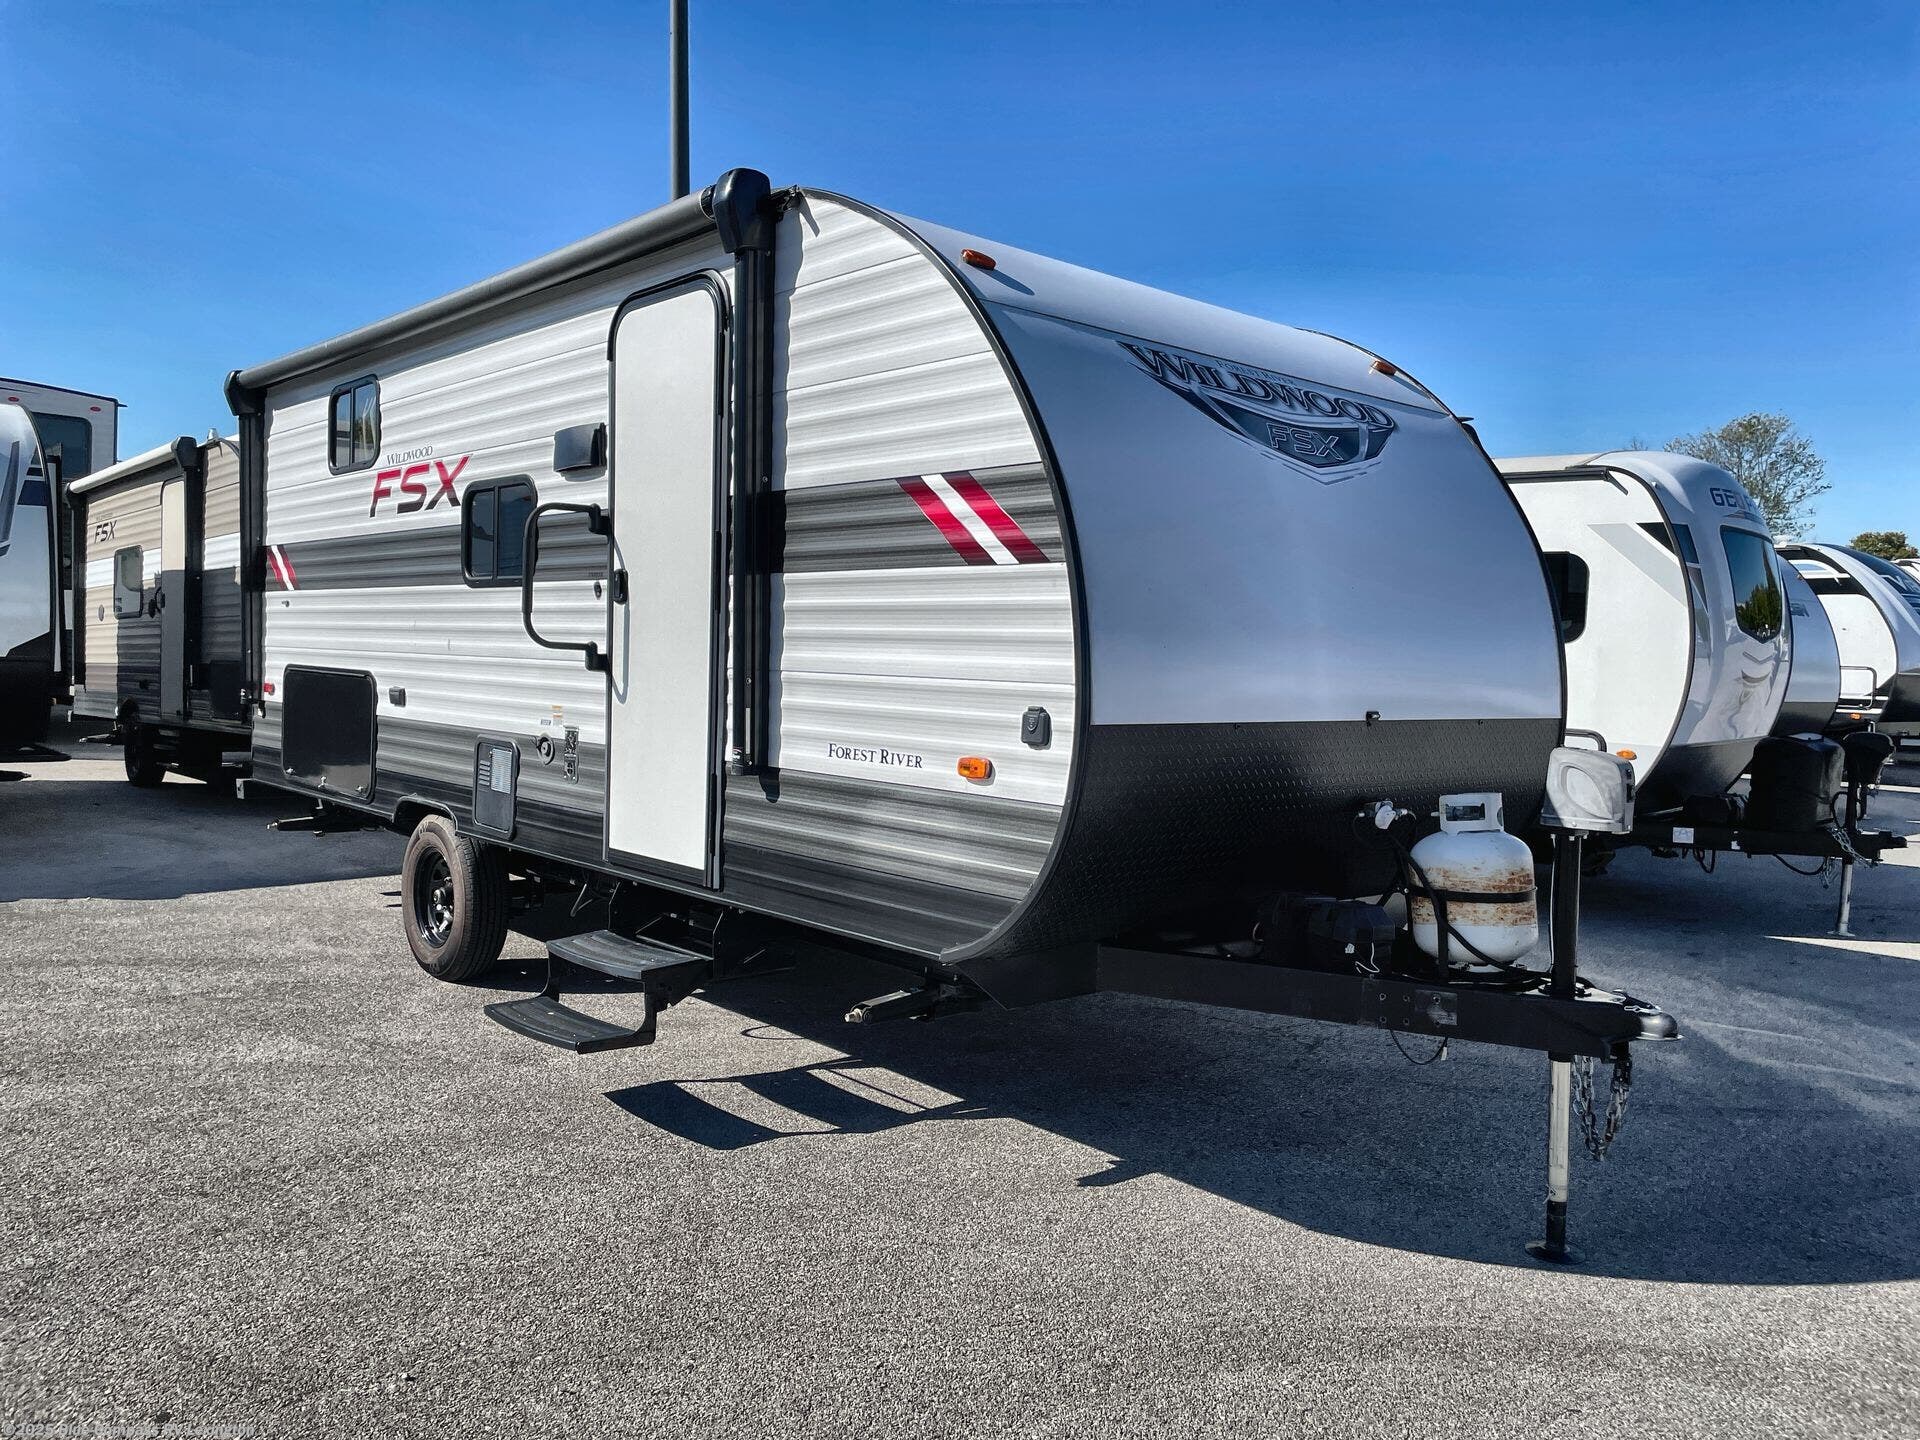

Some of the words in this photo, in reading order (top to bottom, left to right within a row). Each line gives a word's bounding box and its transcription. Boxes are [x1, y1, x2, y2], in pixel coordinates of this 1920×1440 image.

[1115, 340, 1396, 430] WILDWOOD
[386, 445, 433, 465] WILDWOOD
[1266, 422, 1343, 460] FSX
[369, 454, 472, 518] FSX
[94, 520, 117, 544] FSX
[828, 743, 877, 763] FOREST
[879, 748, 922, 769] RIVER
